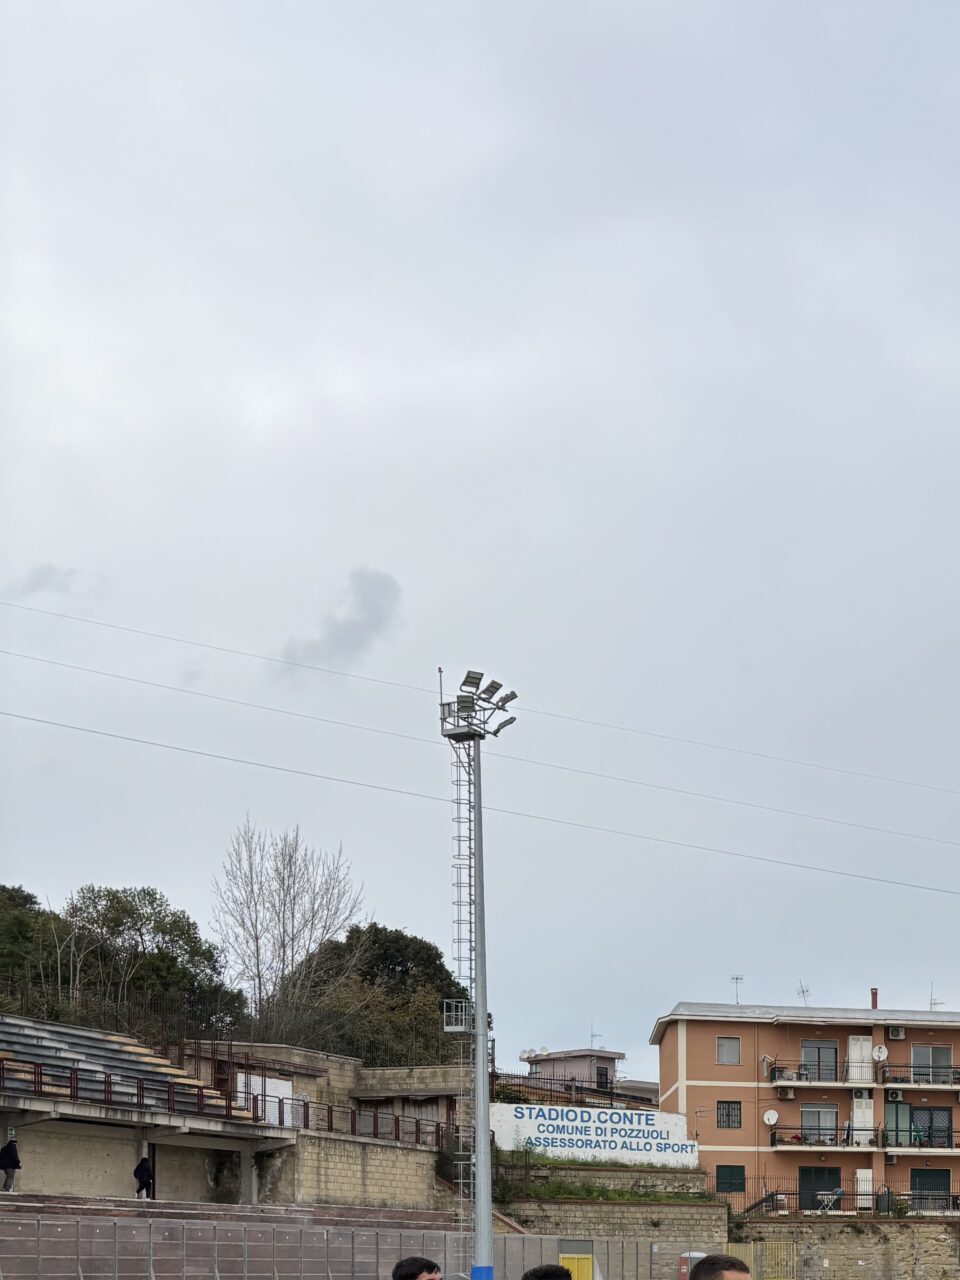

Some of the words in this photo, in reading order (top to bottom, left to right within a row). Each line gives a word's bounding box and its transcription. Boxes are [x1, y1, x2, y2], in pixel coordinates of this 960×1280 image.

[514, 1106, 577, 1123] STADIO
[537, 1123, 591, 1136] COMUNE
[595, 1127, 607, 1137] DI
[611, 1128, 670, 1141] POZZUOLI
[525, 1136, 617, 1151] ASSESSORATO
[620, 1141, 652, 1152] ALLO
[656, 1142, 696, 1154] SPORT
